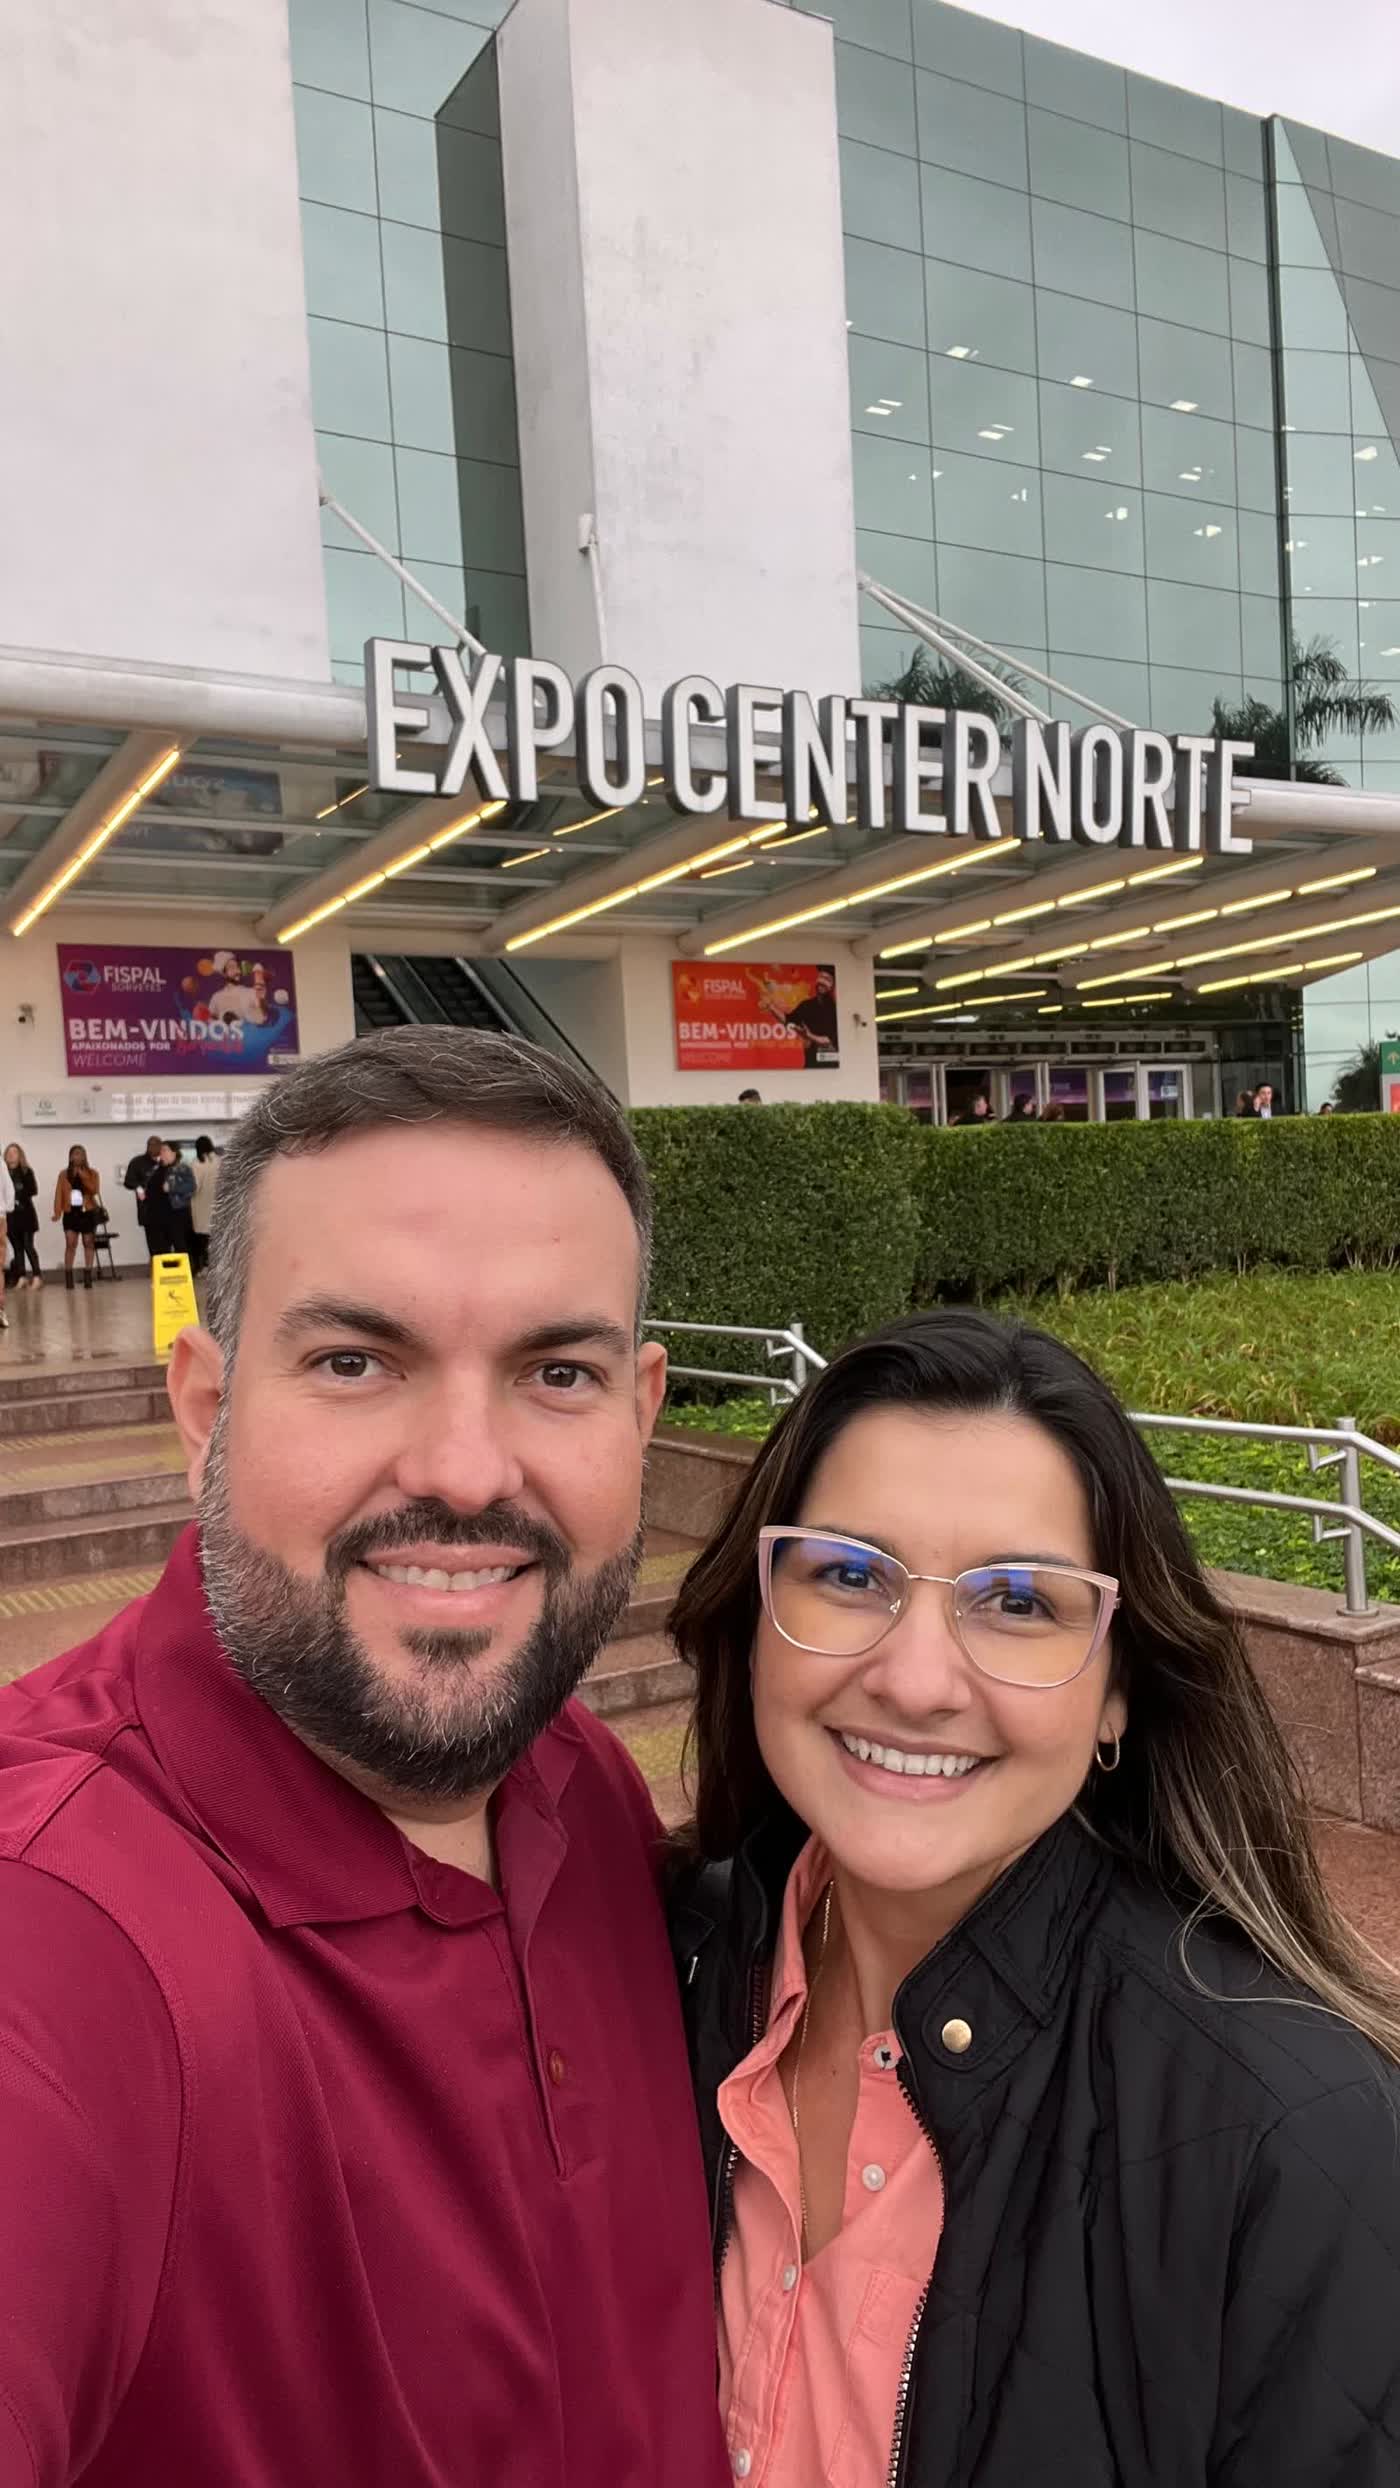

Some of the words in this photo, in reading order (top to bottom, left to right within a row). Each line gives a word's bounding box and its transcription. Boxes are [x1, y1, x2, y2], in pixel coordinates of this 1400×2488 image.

[364, 636, 645, 808] EXPO
[662, 674, 1002, 839] CENTER
[1012, 717, 1256, 855] NORTE
[103, 965, 167, 985] FISPAL
[703, 979, 745, 993] FISPAL
[68, 1018, 244, 1041] BEM-VINDOS
[679, 1022, 798, 1041] BEM-VINDOS
[71, 1041, 146, 1051] APAIXONADOS
[150, 1042, 171, 1051] POR
[72, 1052, 147, 1067] WELCOME
